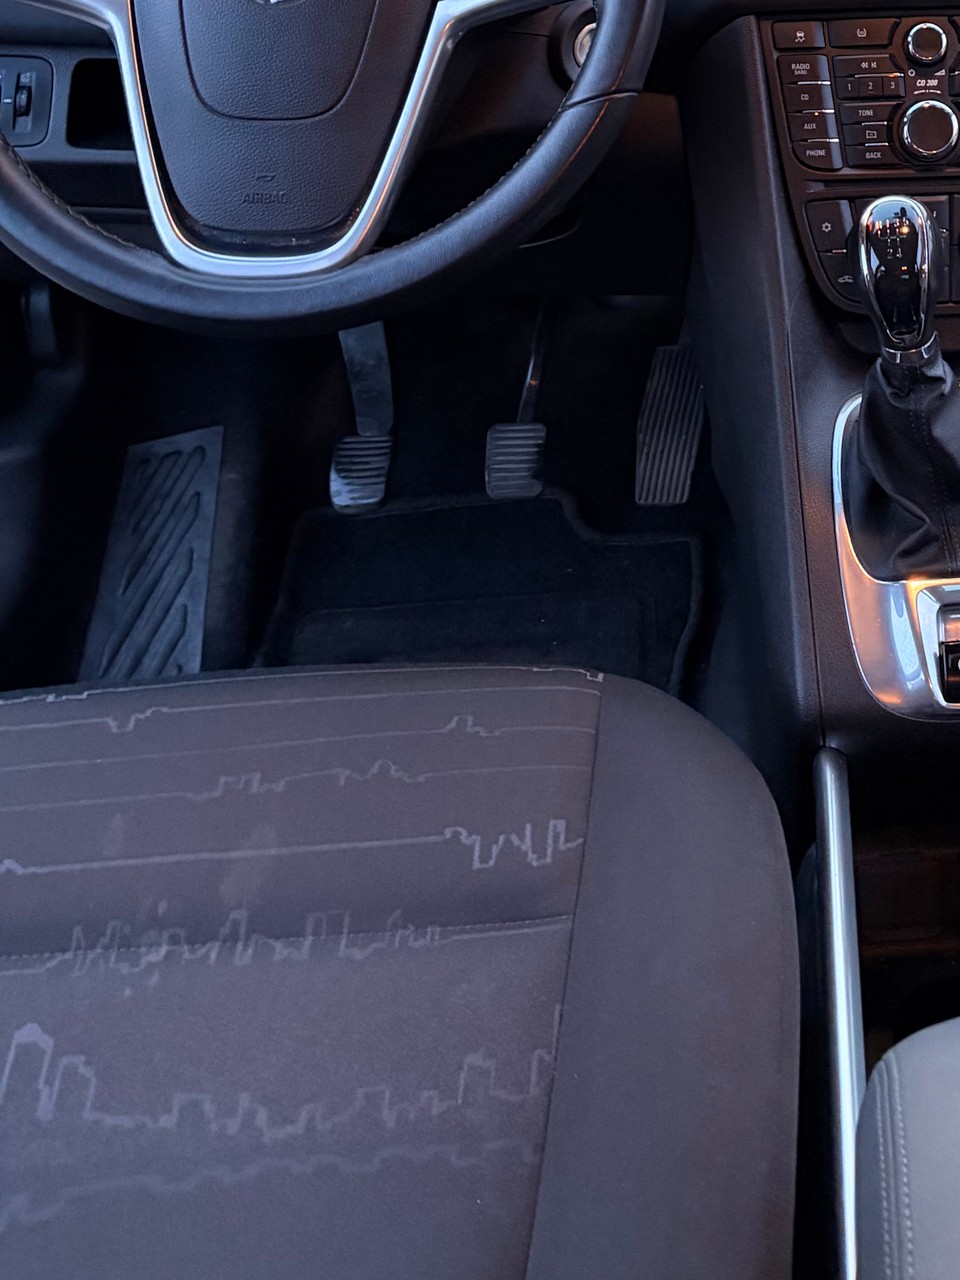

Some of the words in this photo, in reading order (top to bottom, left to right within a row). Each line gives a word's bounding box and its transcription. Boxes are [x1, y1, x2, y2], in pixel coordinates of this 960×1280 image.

[890, 81, 895, 89] 3
[916, 79, 925, 87] CD
[926, 79, 938, 87] 300
[800, 93, 810, 101] CD
[858, 109, 874, 117] TONE
[806, 149, 826, 157] PHONE
[887, 248, 894, 259] 2
[896, 247, 902, 258] 4
